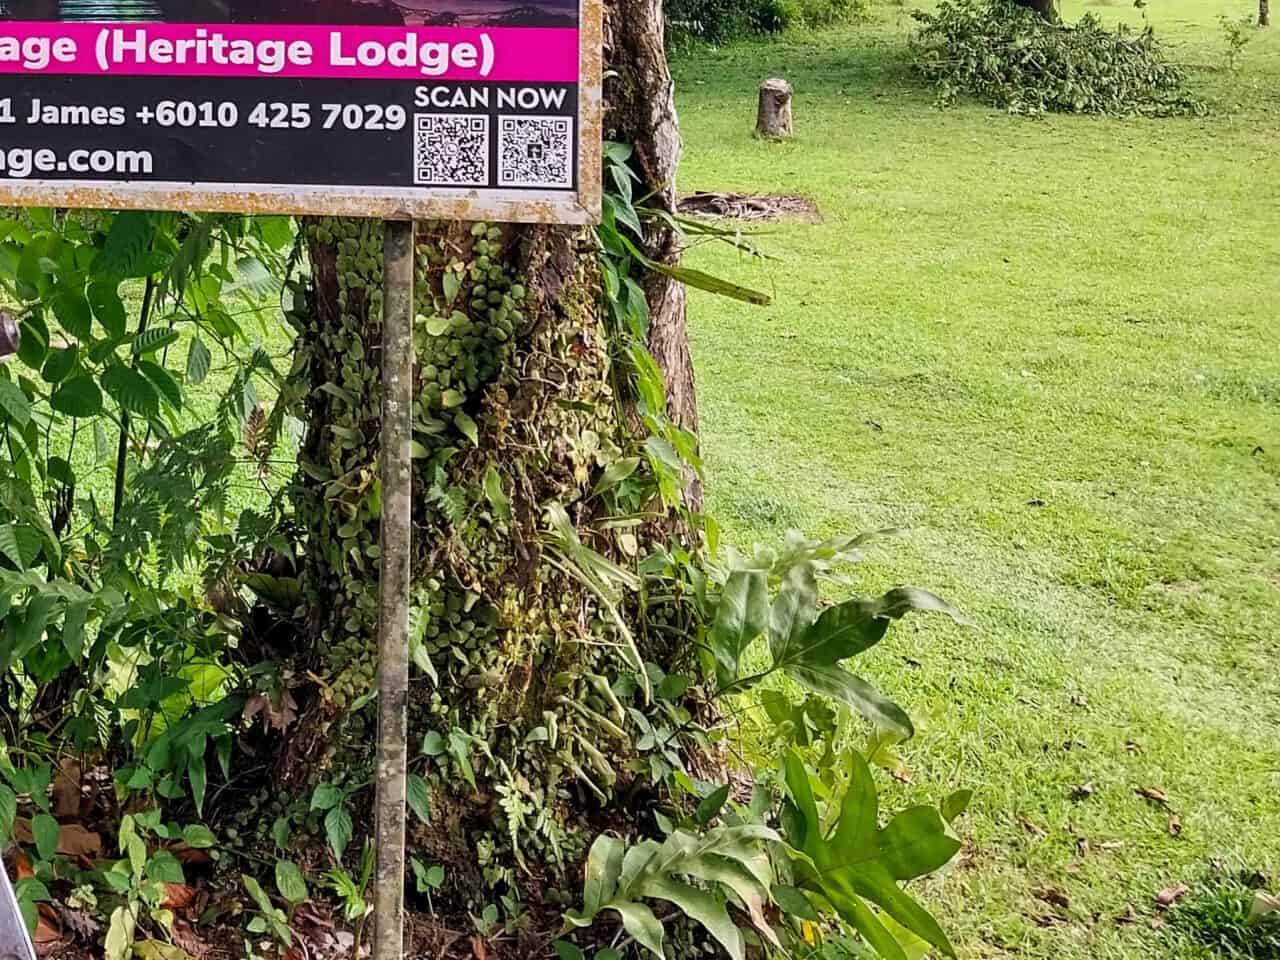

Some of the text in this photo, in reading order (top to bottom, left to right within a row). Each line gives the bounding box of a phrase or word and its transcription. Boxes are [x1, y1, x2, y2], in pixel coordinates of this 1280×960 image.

[94, 29, 313, 73] (Heritage
[330, 32, 495, 76] Lodge)
[414, 85, 567, 109] SCAN NOW
[26, 98, 126, 125] James
[135, 100, 238, 127] +6010
[247, 102, 311, 129] 425
[321, 103, 406, 131] 7029
